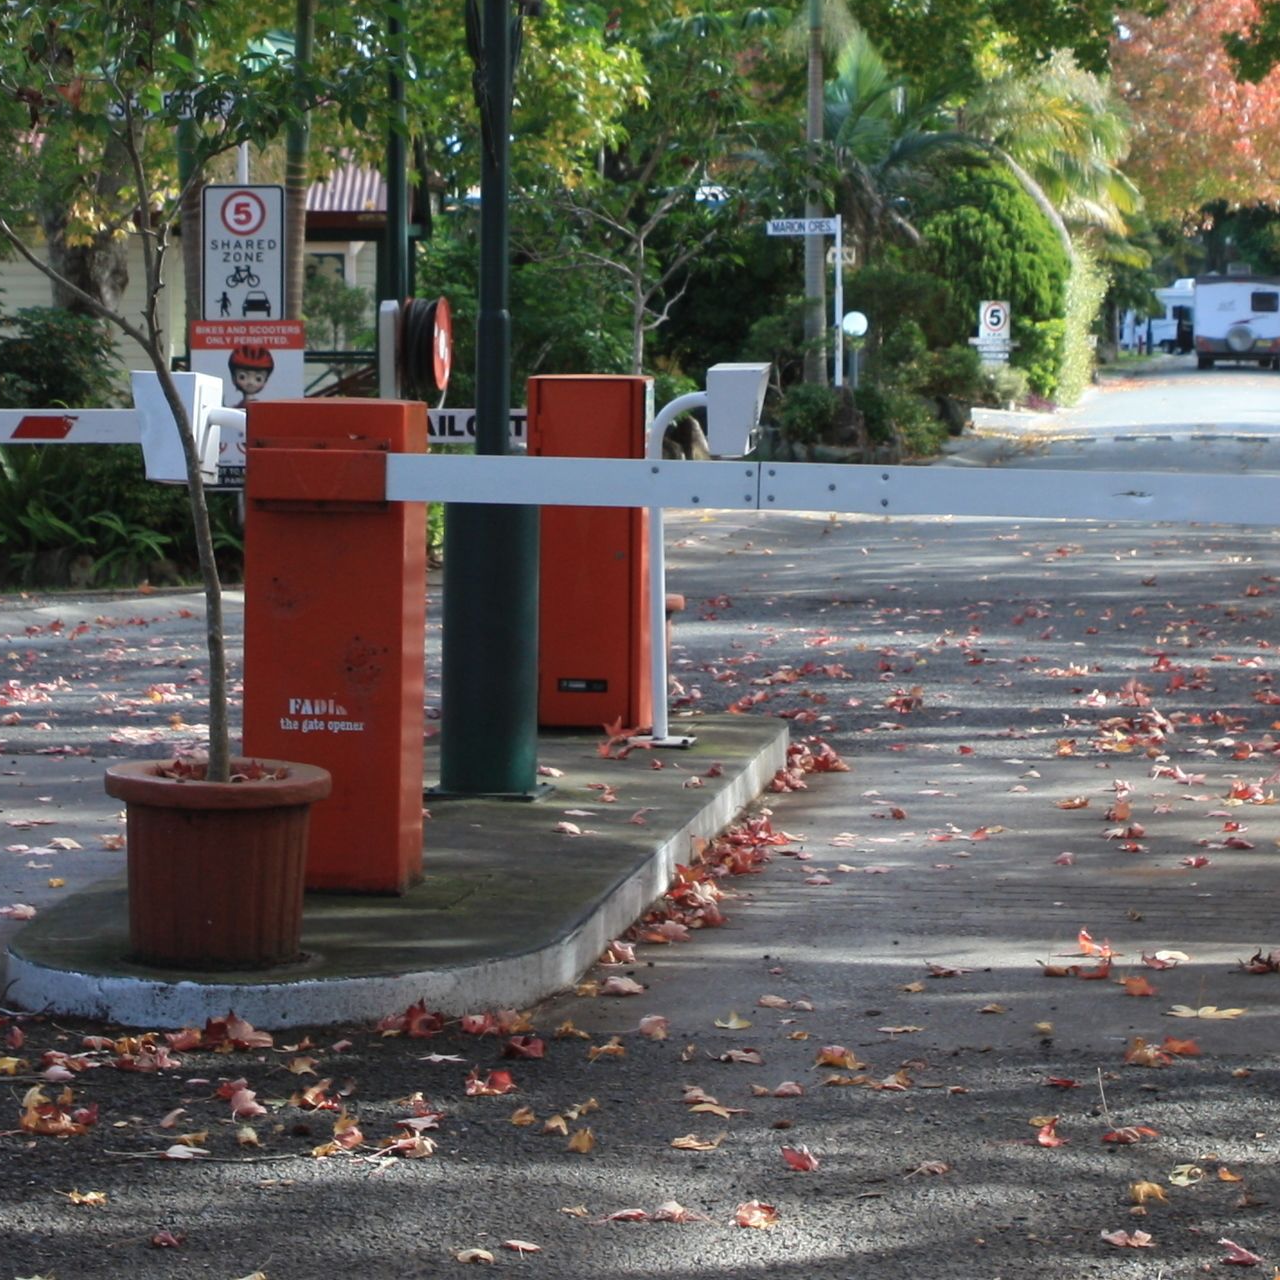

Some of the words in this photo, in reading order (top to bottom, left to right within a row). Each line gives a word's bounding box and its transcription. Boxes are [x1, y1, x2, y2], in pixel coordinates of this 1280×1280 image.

[233, 202, 253, 226] 5
[772, 221, 806, 233] MARION
[210, 239, 277, 251] SHARED
[222, 251, 264, 263] ZONE
[989, 309, 1002, 327] 5
[195, 326, 224, 334] BIKES
[227, 326, 247, 334] AND
[249, 326, 300, 334] SCOOTERS
[206, 336, 231, 345] ONLY
[280, 717, 299, 730] the
[301, 718, 325, 733] gate
[327, 720, 365, 733] opener
